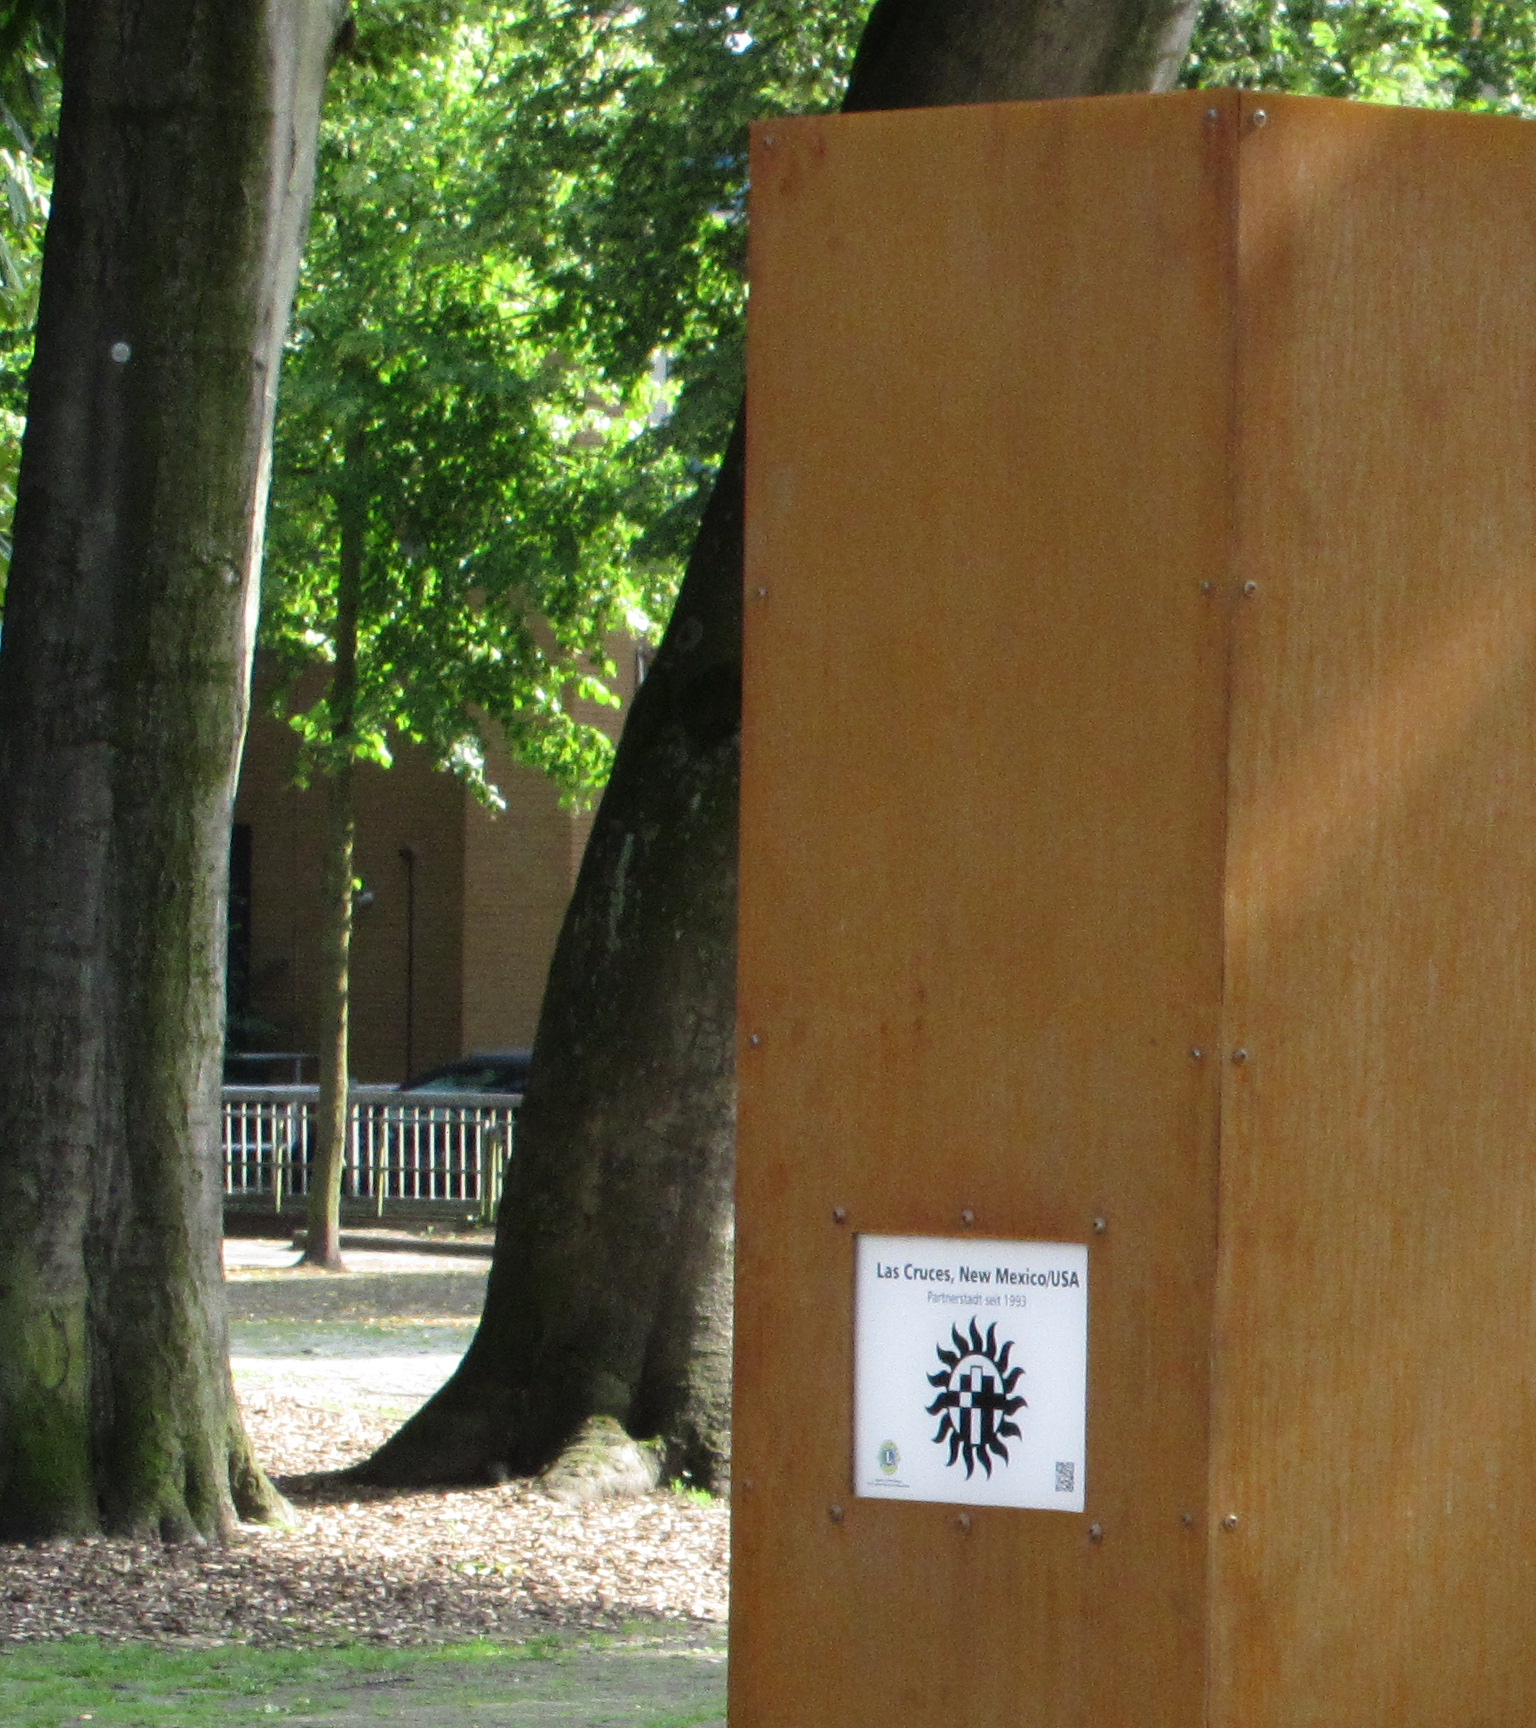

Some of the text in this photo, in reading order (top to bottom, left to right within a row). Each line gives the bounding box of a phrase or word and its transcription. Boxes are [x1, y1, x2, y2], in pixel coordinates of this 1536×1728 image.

[876, 1262, 1080, 1288] Las Cruces, New Mexico/USA
[927, 1291, 1027, 1308] Partnerstadt seit 1993
